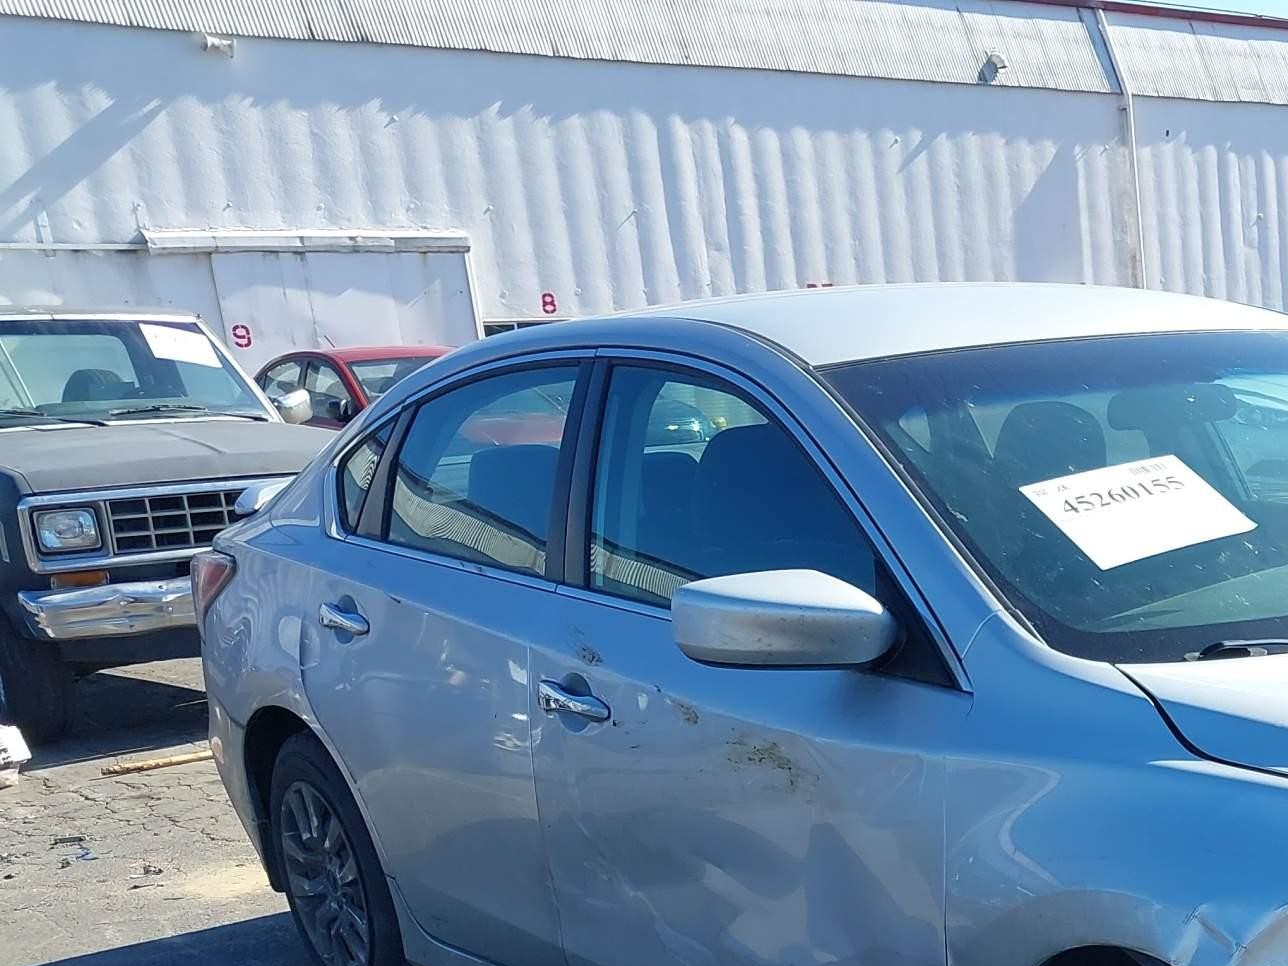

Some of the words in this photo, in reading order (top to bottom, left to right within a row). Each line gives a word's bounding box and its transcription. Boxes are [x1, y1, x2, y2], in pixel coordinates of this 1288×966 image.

[541, 292, 557, 314] 8
[231, 324, 252, 348] 9
[1063, 475, 1185, 514] 45260155
